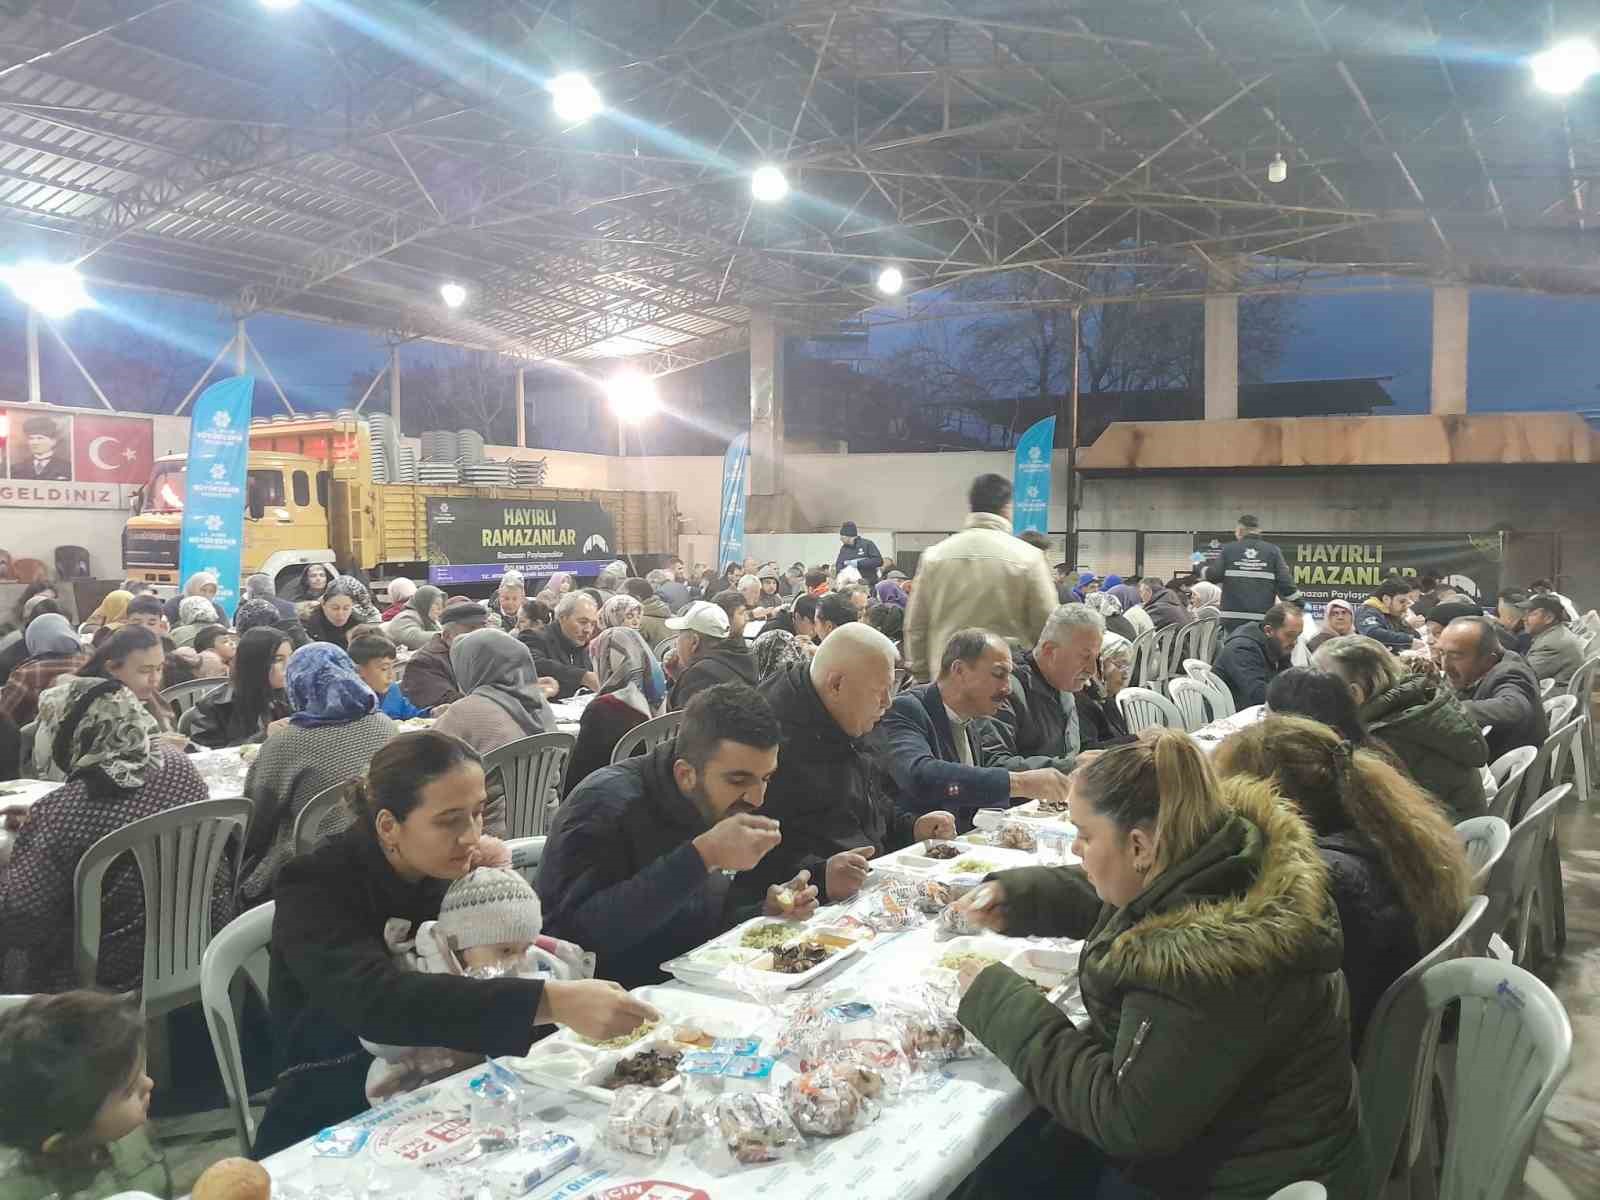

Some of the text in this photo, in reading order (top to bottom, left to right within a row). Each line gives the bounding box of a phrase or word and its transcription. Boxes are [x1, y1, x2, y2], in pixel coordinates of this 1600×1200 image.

[503, 508, 557, 526] HAYIRLI
[481, 528, 577, 547] RAMAZANLAR
[1297, 544, 1383, 563] HAYIRLI
